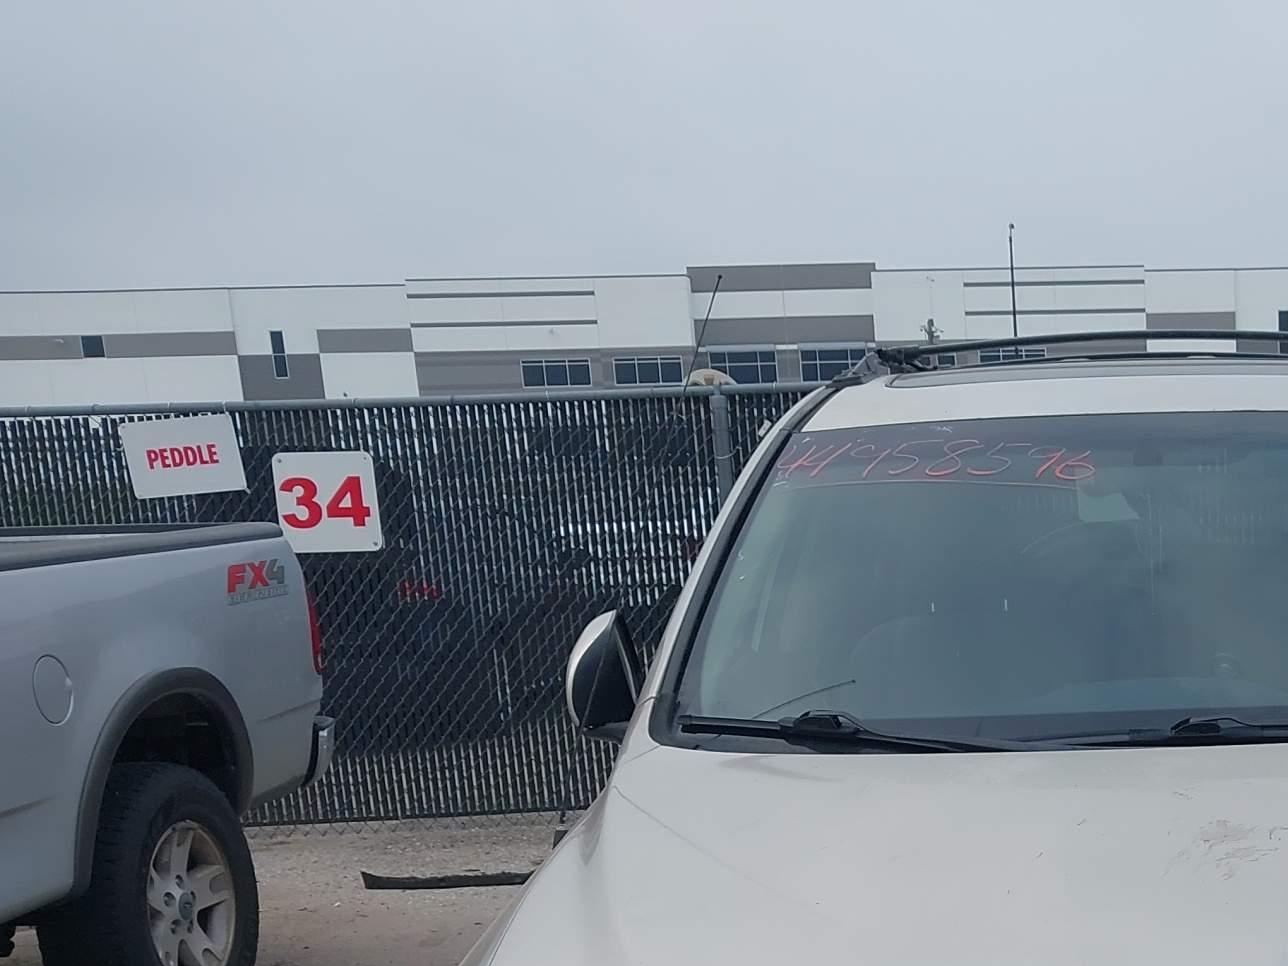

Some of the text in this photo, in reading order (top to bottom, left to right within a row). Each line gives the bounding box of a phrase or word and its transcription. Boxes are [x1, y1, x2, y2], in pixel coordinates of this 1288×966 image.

[146, 444, 220, 469] PEDDLE
[777, 438, 1096, 479] 44958596
[279, 475, 371, 529] 34
[227, 558, 285, 593] FX4
